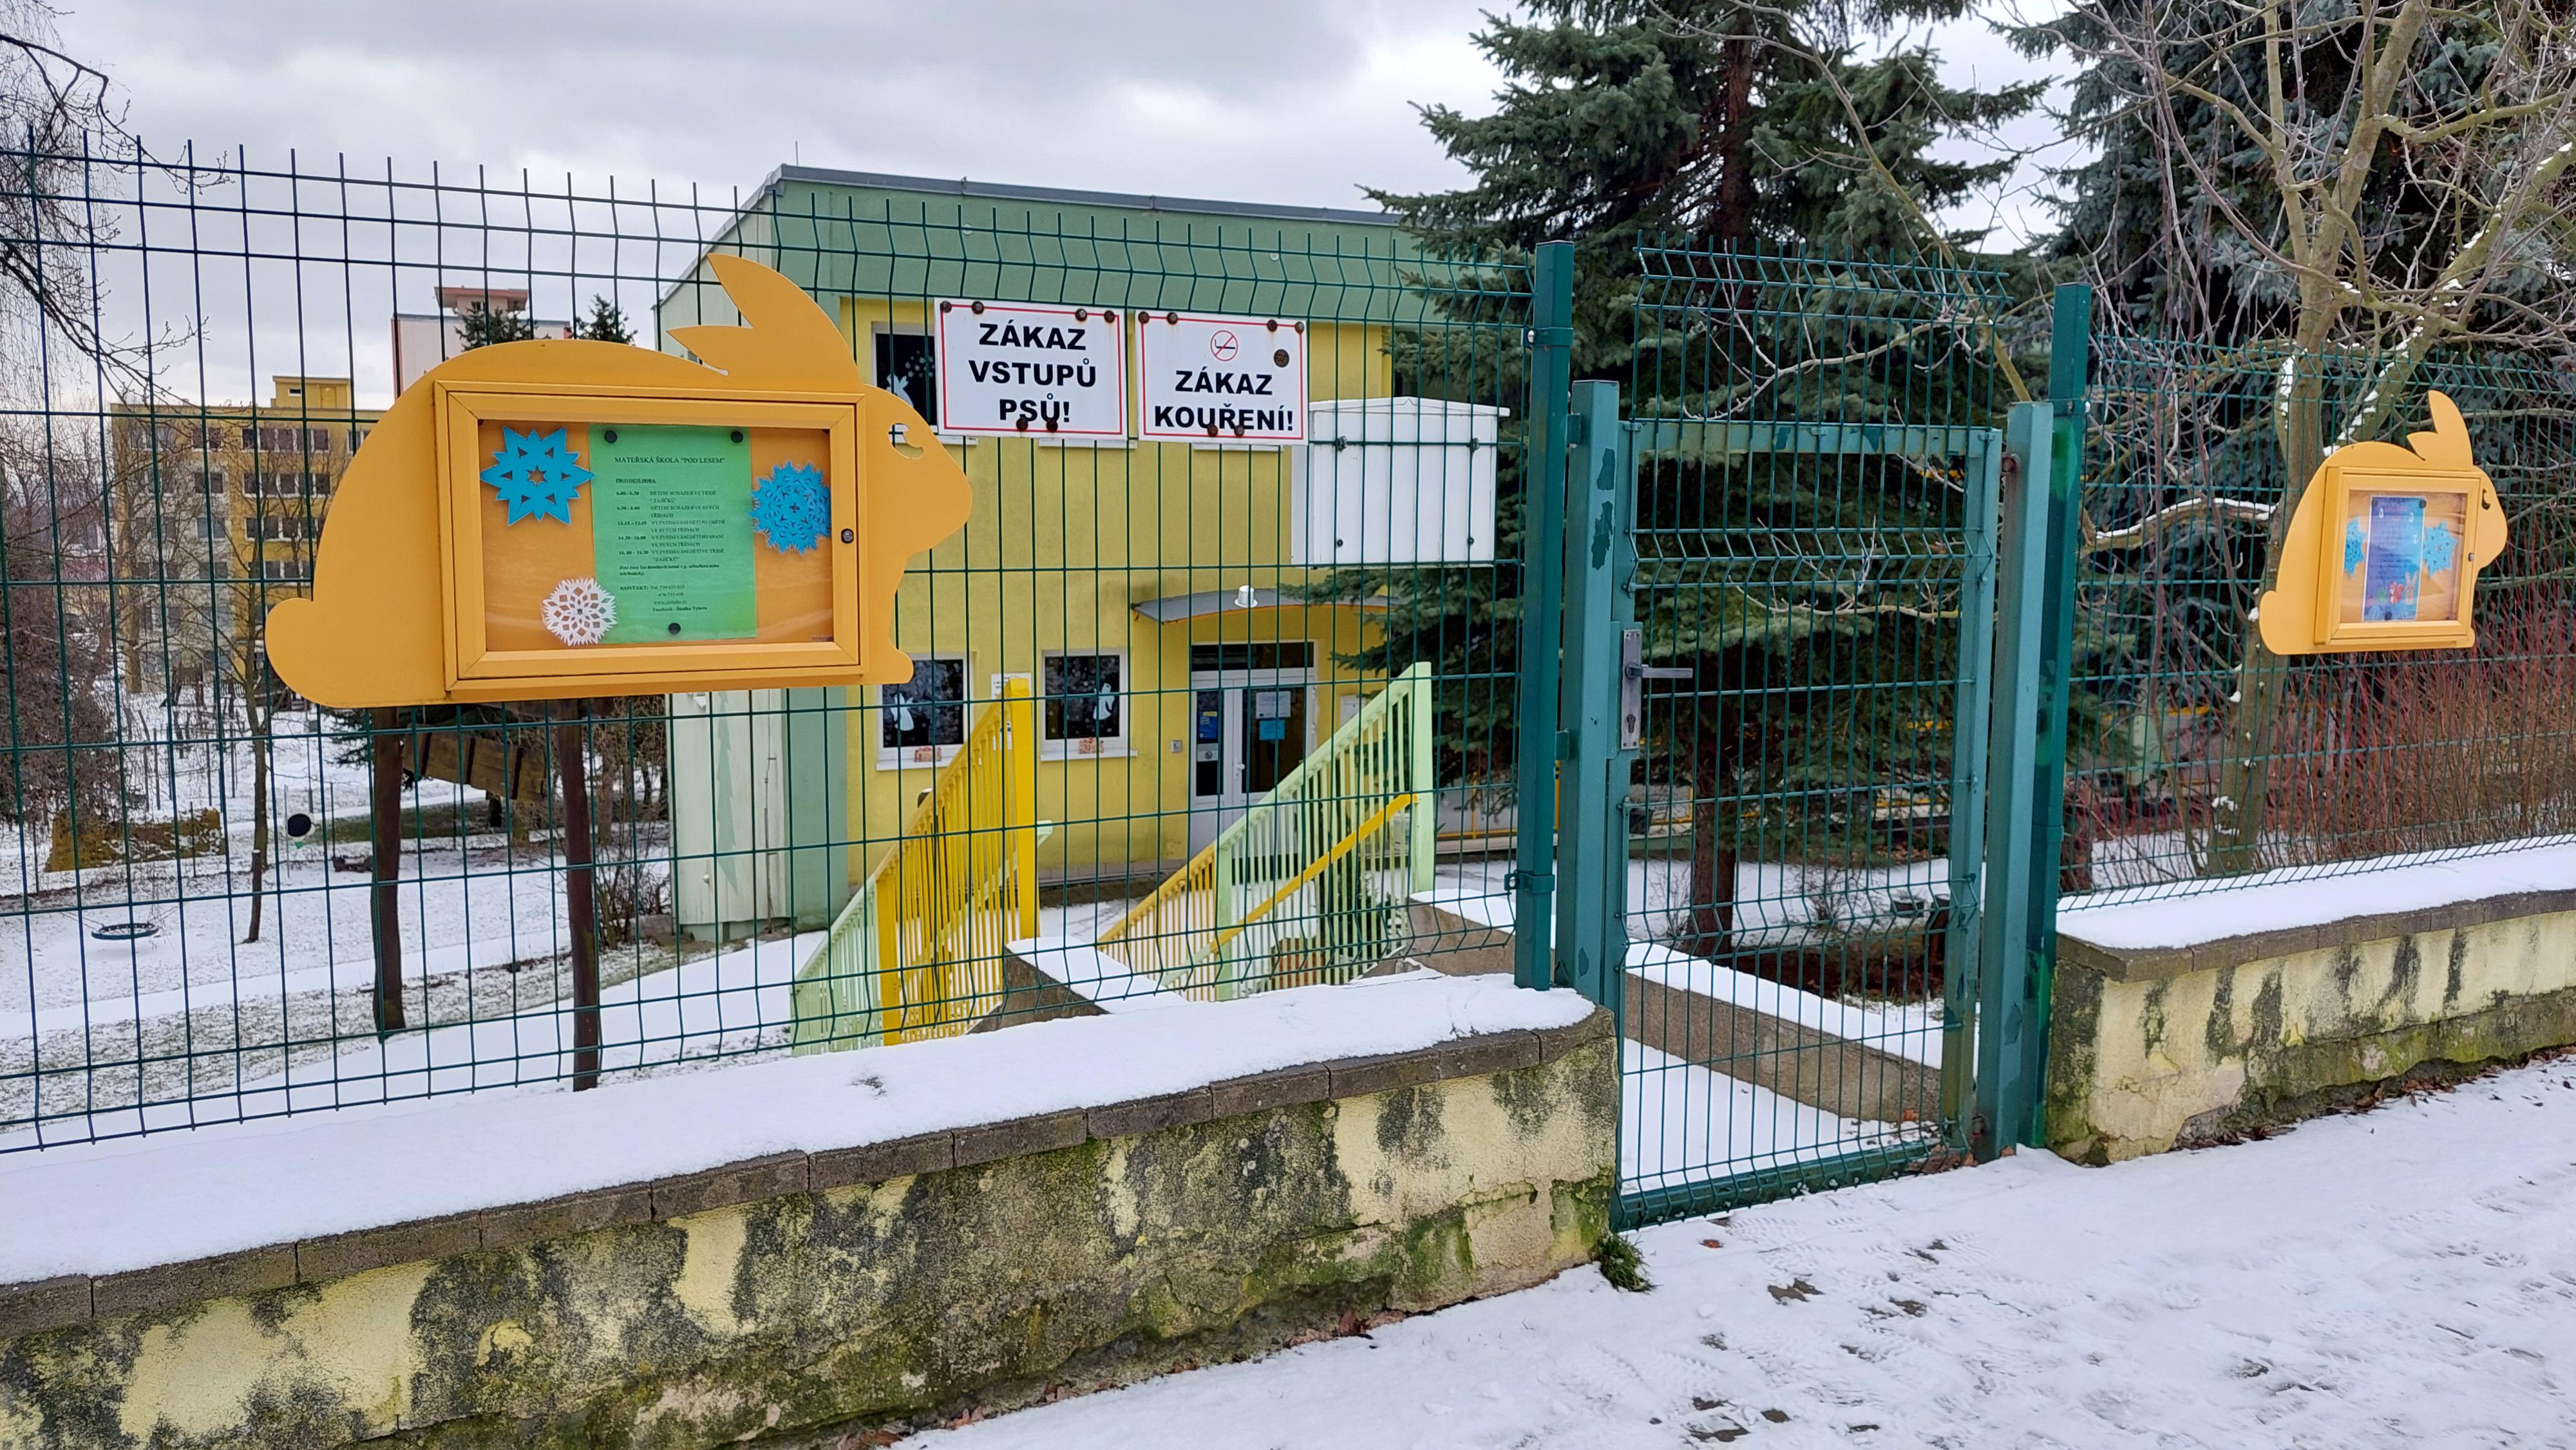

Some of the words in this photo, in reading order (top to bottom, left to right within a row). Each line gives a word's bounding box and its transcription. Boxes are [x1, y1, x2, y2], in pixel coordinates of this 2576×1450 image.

[979, 319, 1086, 351] ZÁKAZ
[969, 358, 1097, 388] VSTUPŮ
[1175, 366, 1273, 396] ZÁKAZ
[999, 393, 1070, 424] PSŮ!
[1154, 402, 1294, 431] KOUŘENÍ!
